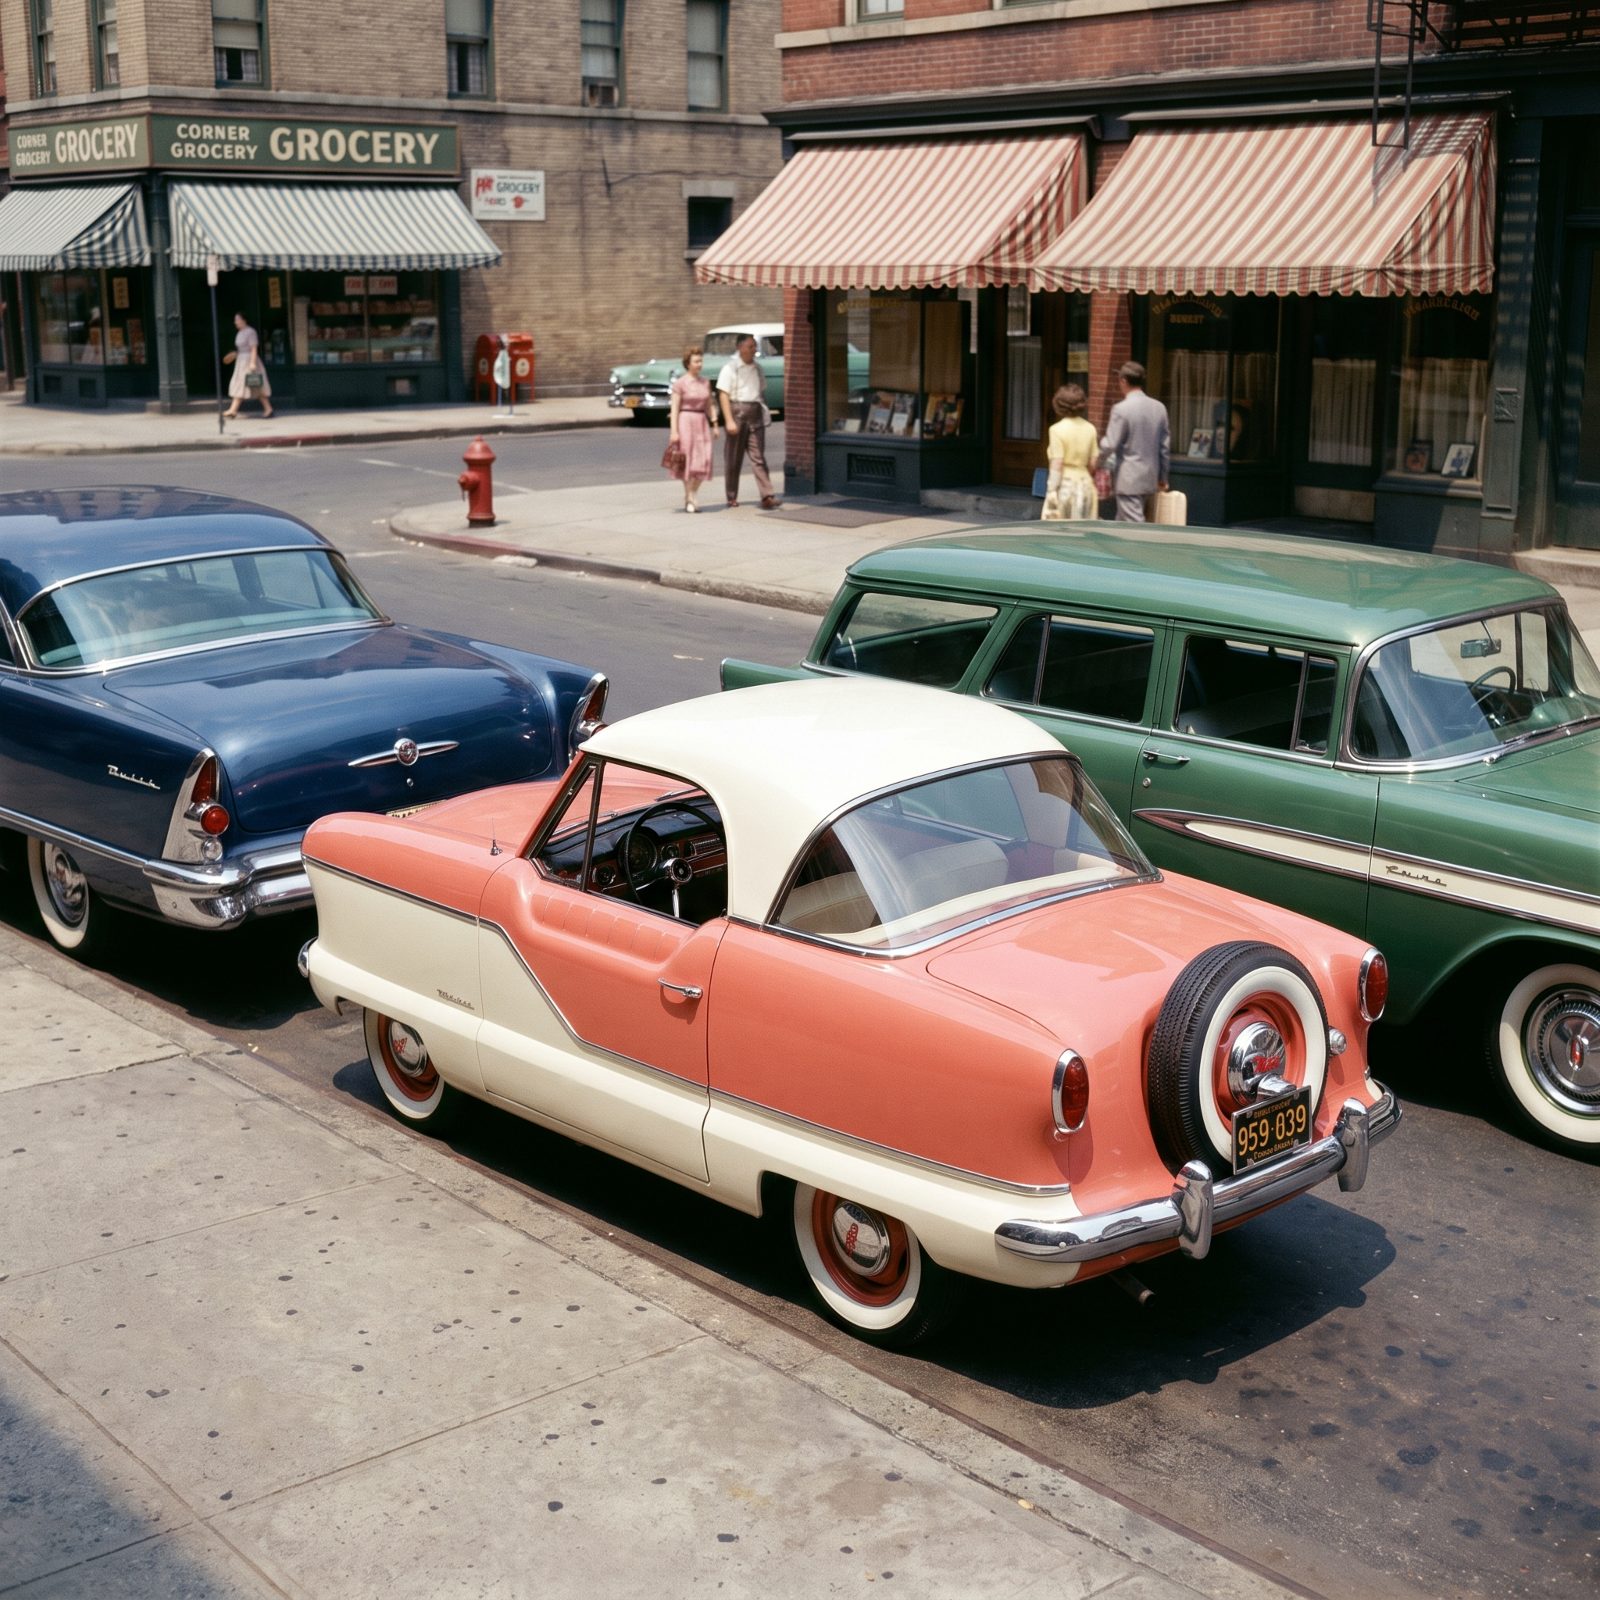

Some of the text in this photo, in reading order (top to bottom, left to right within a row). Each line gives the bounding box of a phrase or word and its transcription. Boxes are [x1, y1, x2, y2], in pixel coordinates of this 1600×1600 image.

[177, 123, 250, 141] CORNER
[17, 134, 47, 149] CORNER
[55, 123, 138, 164] GROCERY
[269, 126, 439, 165] GROCERY
[16, 151, 51, 166] GROCERY
[170, 142, 258, 160] GROCERY
